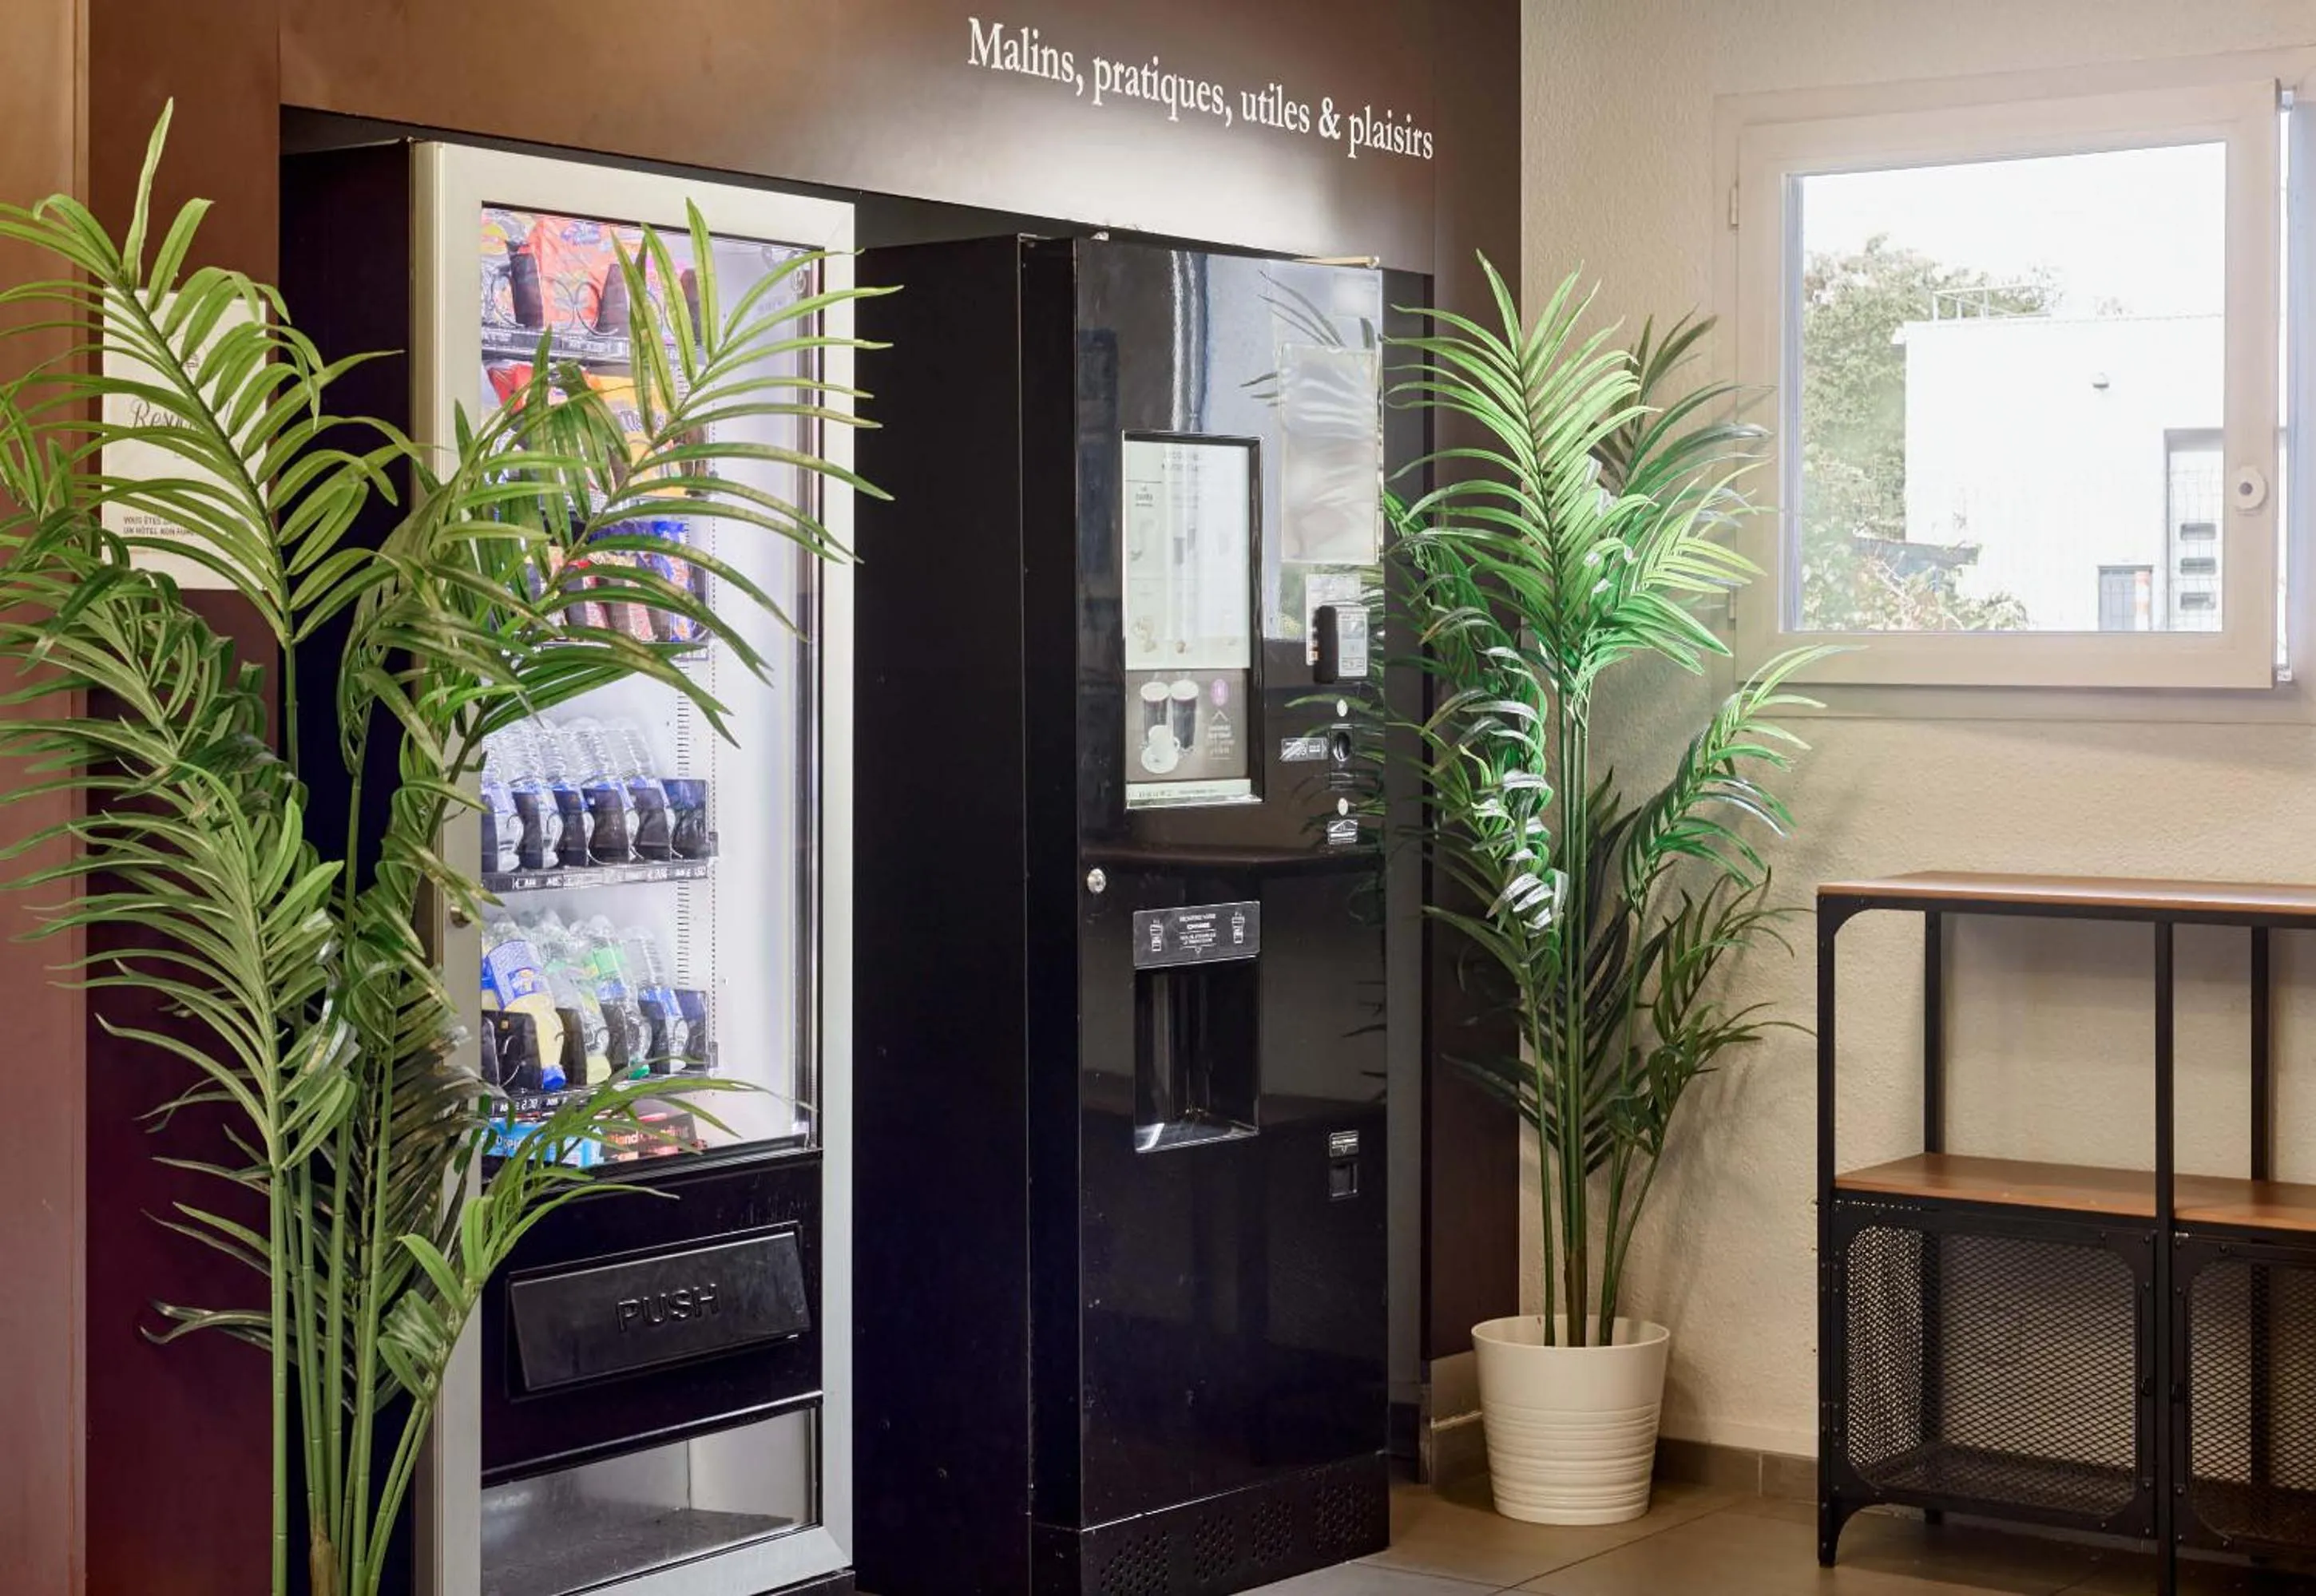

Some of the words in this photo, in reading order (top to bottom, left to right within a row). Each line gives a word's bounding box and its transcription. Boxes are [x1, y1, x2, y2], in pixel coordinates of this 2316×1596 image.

[967, 17, 1084, 96] Malins,
[1093, 57, 1233, 127] pratiques,
[1240, 83, 1311, 134] utiles
[1318, 97, 1342, 140] &
[1348, 105, 1435, 160] plaisirs
[616, 1282, 720, 1333] PUSH
